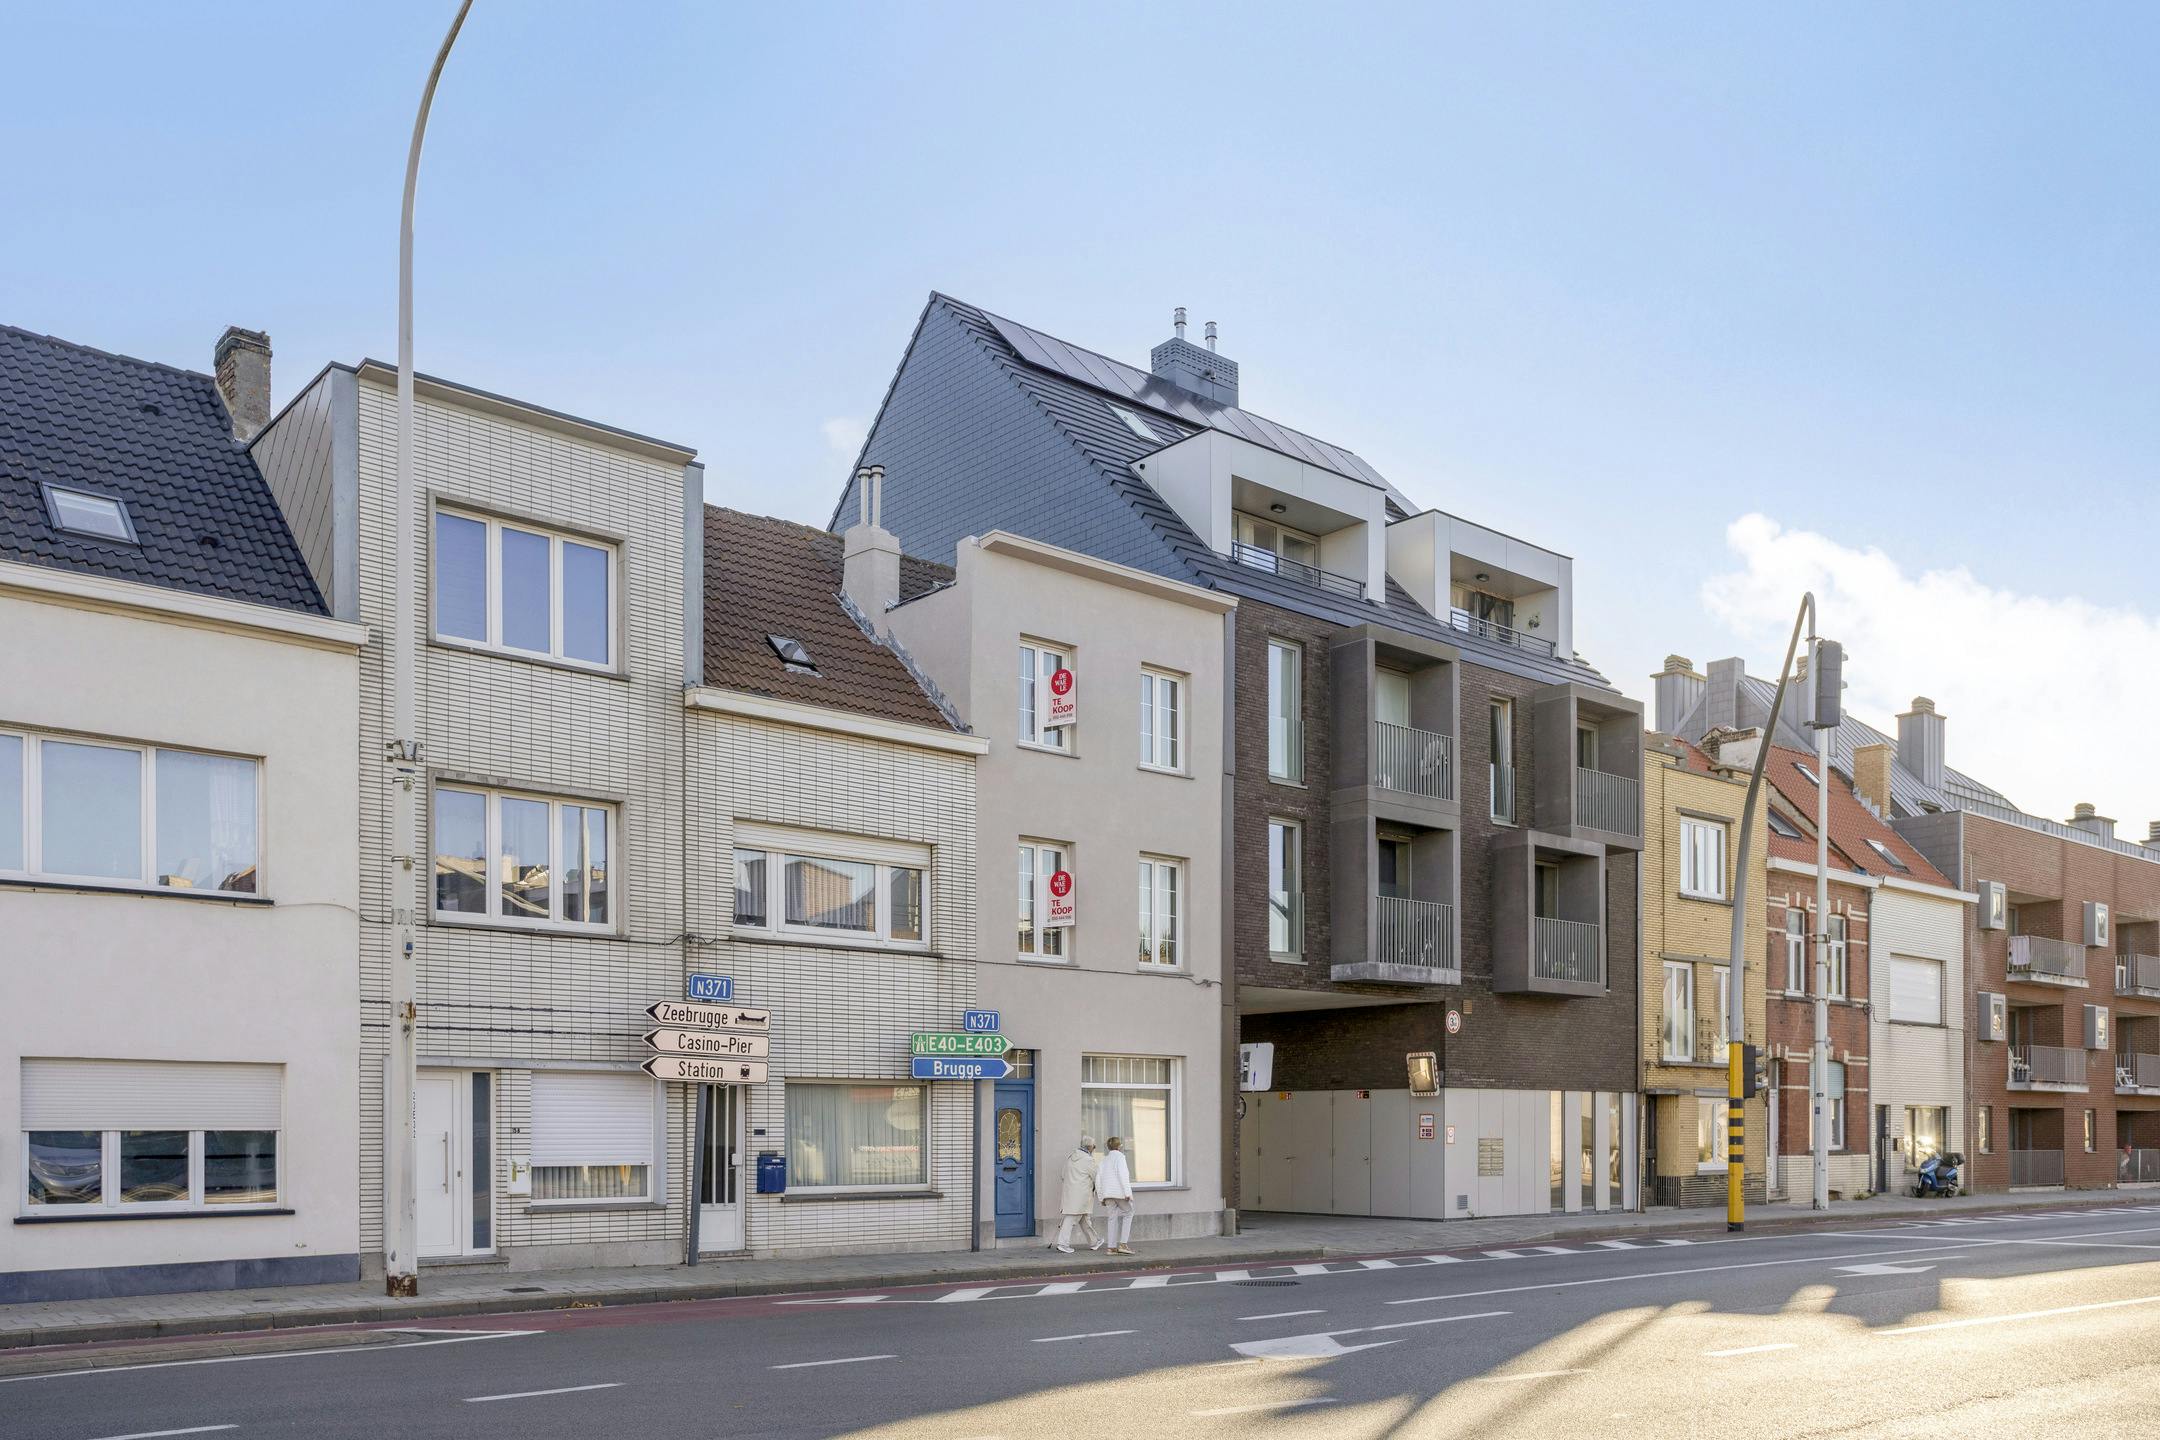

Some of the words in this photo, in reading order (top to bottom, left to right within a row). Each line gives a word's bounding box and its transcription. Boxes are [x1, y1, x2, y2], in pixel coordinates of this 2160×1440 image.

[1053, 704, 1073, 714] KOOP
[1052, 907, 1072, 915] KOOP
[696, 979, 727, 996] N371
[662, 1004, 728, 1028] Zeebrugge
[970, 1014, 995, 1029] N371
[678, 1033, 753, 1054] Casino-Pier
[929, 1036, 1002, 1052] E40-E403
[678, 1060, 724, 1079] Station
[933, 1060, 982, 1079] Brugge
